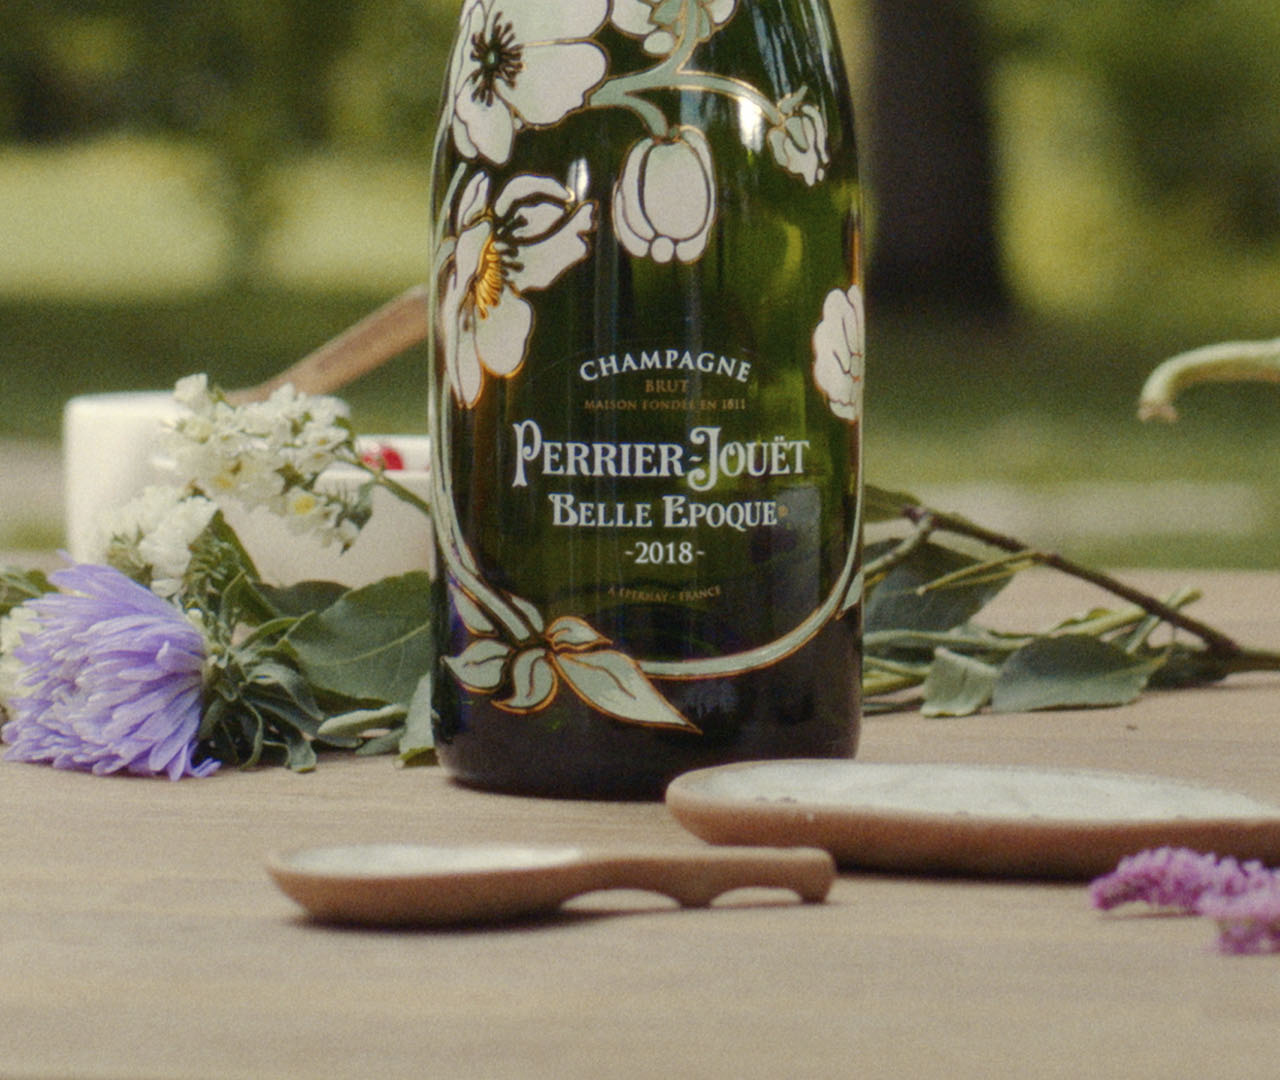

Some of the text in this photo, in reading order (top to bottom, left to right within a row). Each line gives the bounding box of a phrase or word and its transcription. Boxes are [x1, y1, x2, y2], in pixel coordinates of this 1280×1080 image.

[579, 348, 752, 383] CHAMPAGNE
[645, 379, 688, 393] BRUT
[584, 399, 637, 410] MAISON
[701, 399, 718, 410] EN
[722, 399, 746, 410] 1811
[512, 419, 810, 492] PERRIER-JOUËT
[548, 493, 778, 532] BELLE EPOQUE
